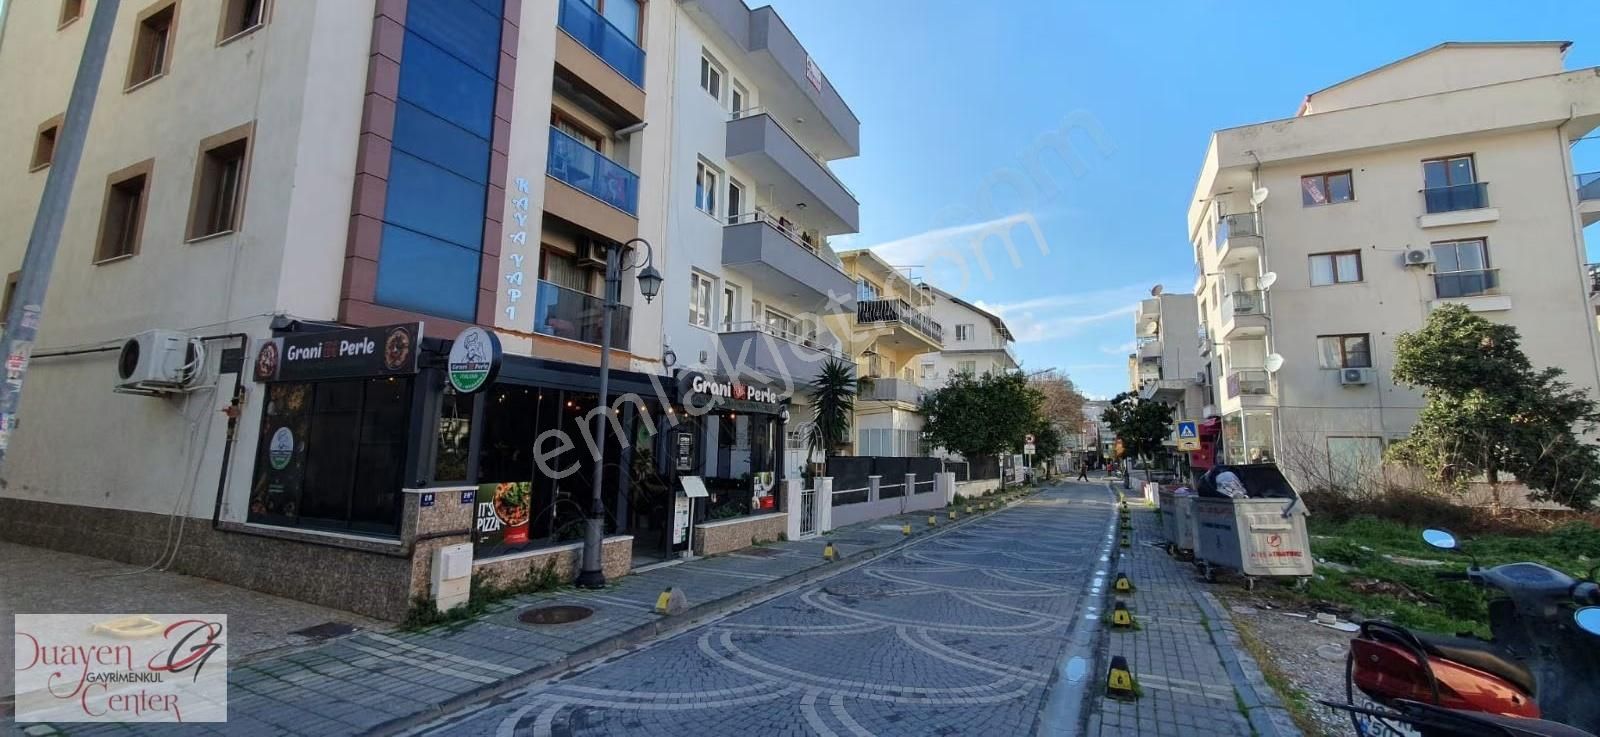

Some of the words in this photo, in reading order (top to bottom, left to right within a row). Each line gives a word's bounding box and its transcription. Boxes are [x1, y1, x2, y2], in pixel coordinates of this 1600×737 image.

[510, 177, 529, 246] KAYA
[505, 253, 524, 321] YAPI
[288, 342, 323, 361] Grani
[339, 336, 376, 357] Perle
[692, 376, 732, 398] Grani
[747, 385, 776, 404] Perle
[477, 502, 494, 518] IT'S
[477, 517, 501, 533] PIZZA
